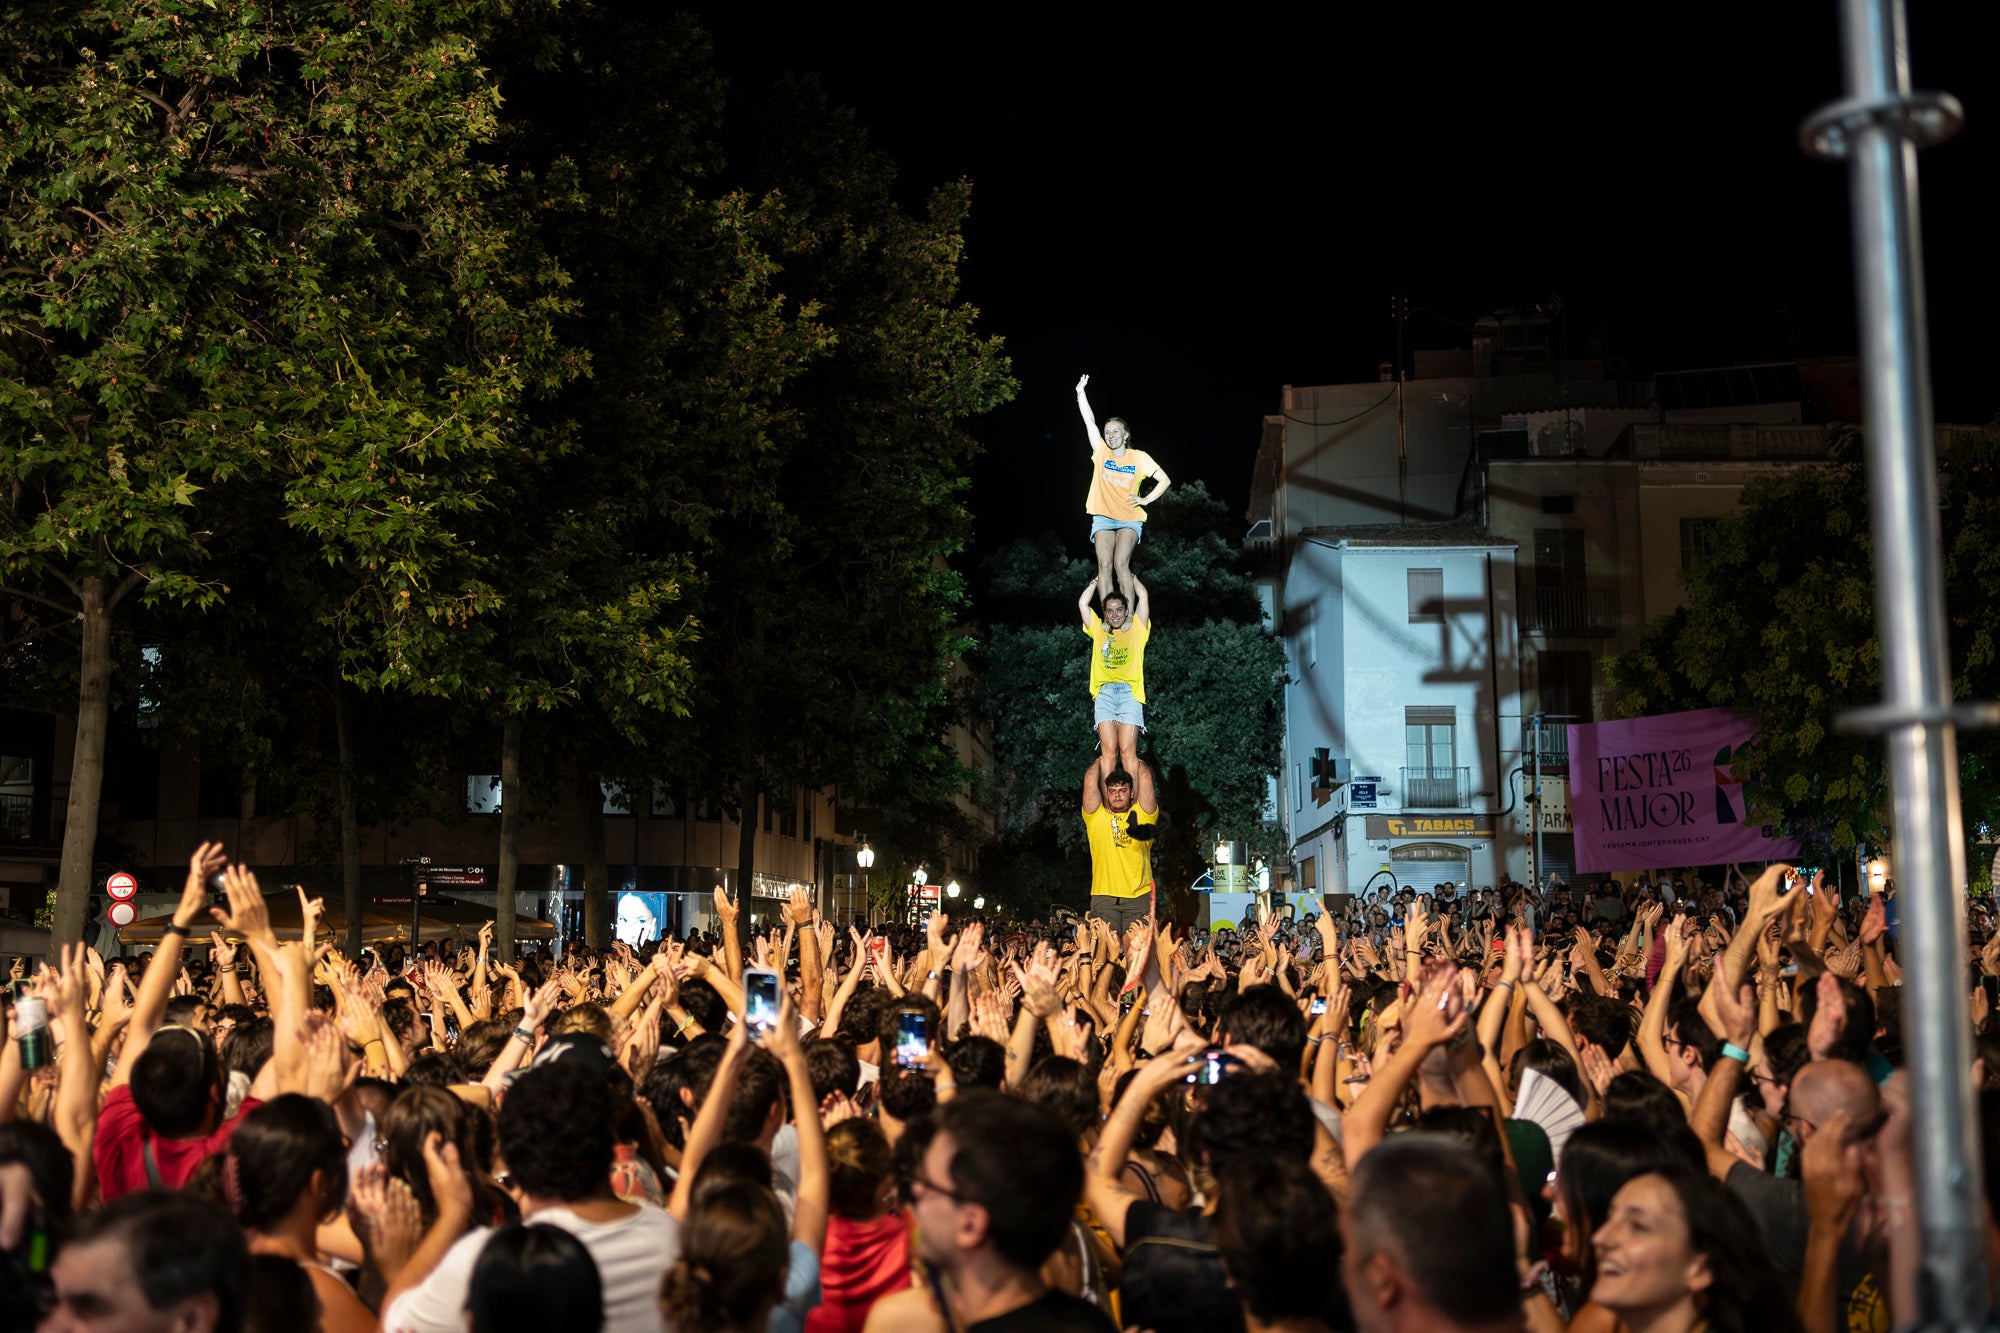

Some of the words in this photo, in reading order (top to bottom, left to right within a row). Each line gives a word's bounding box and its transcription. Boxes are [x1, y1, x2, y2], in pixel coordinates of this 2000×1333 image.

[1597, 751, 1674, 792] FESTA
[1413, 819, 1475, 831] TABACS
[1600, 791, 1696, 832] MAJOR
